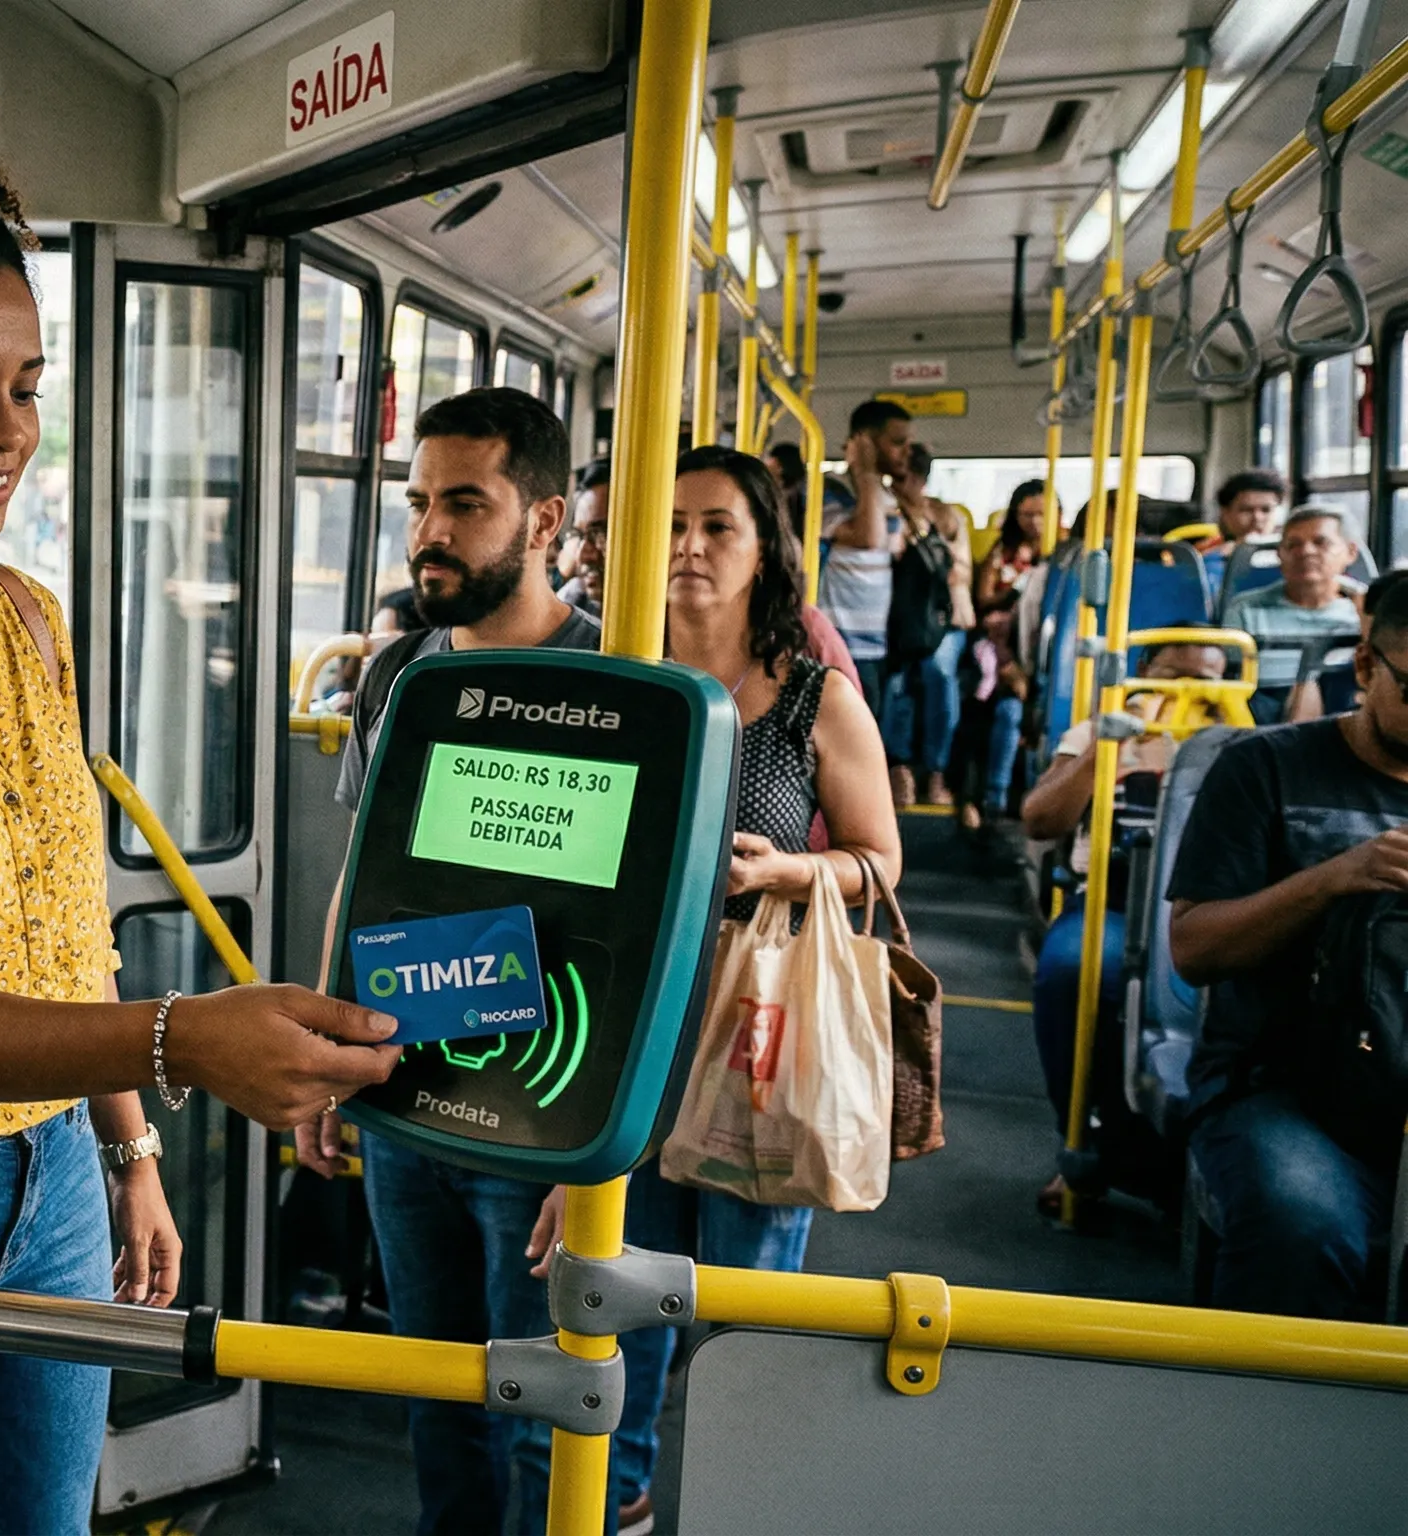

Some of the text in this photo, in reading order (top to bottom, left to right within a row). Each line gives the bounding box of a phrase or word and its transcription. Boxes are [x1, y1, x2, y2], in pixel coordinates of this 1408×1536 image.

[290, 41, 388, 132] SAÍDA
[488, 695, 621, 730] Prodata
[452, 757, 612, 793] SALDO: R$ 18,30
[470, 796, 574, 827] PASSAGEM
[469, 821, 563, 850] DEBITADA
[368, 952, 527, 998] OTIMIZA
[481, 1007, 537, 1024] RIOCARD
[415, 1090, 500, 1129] Prodata
